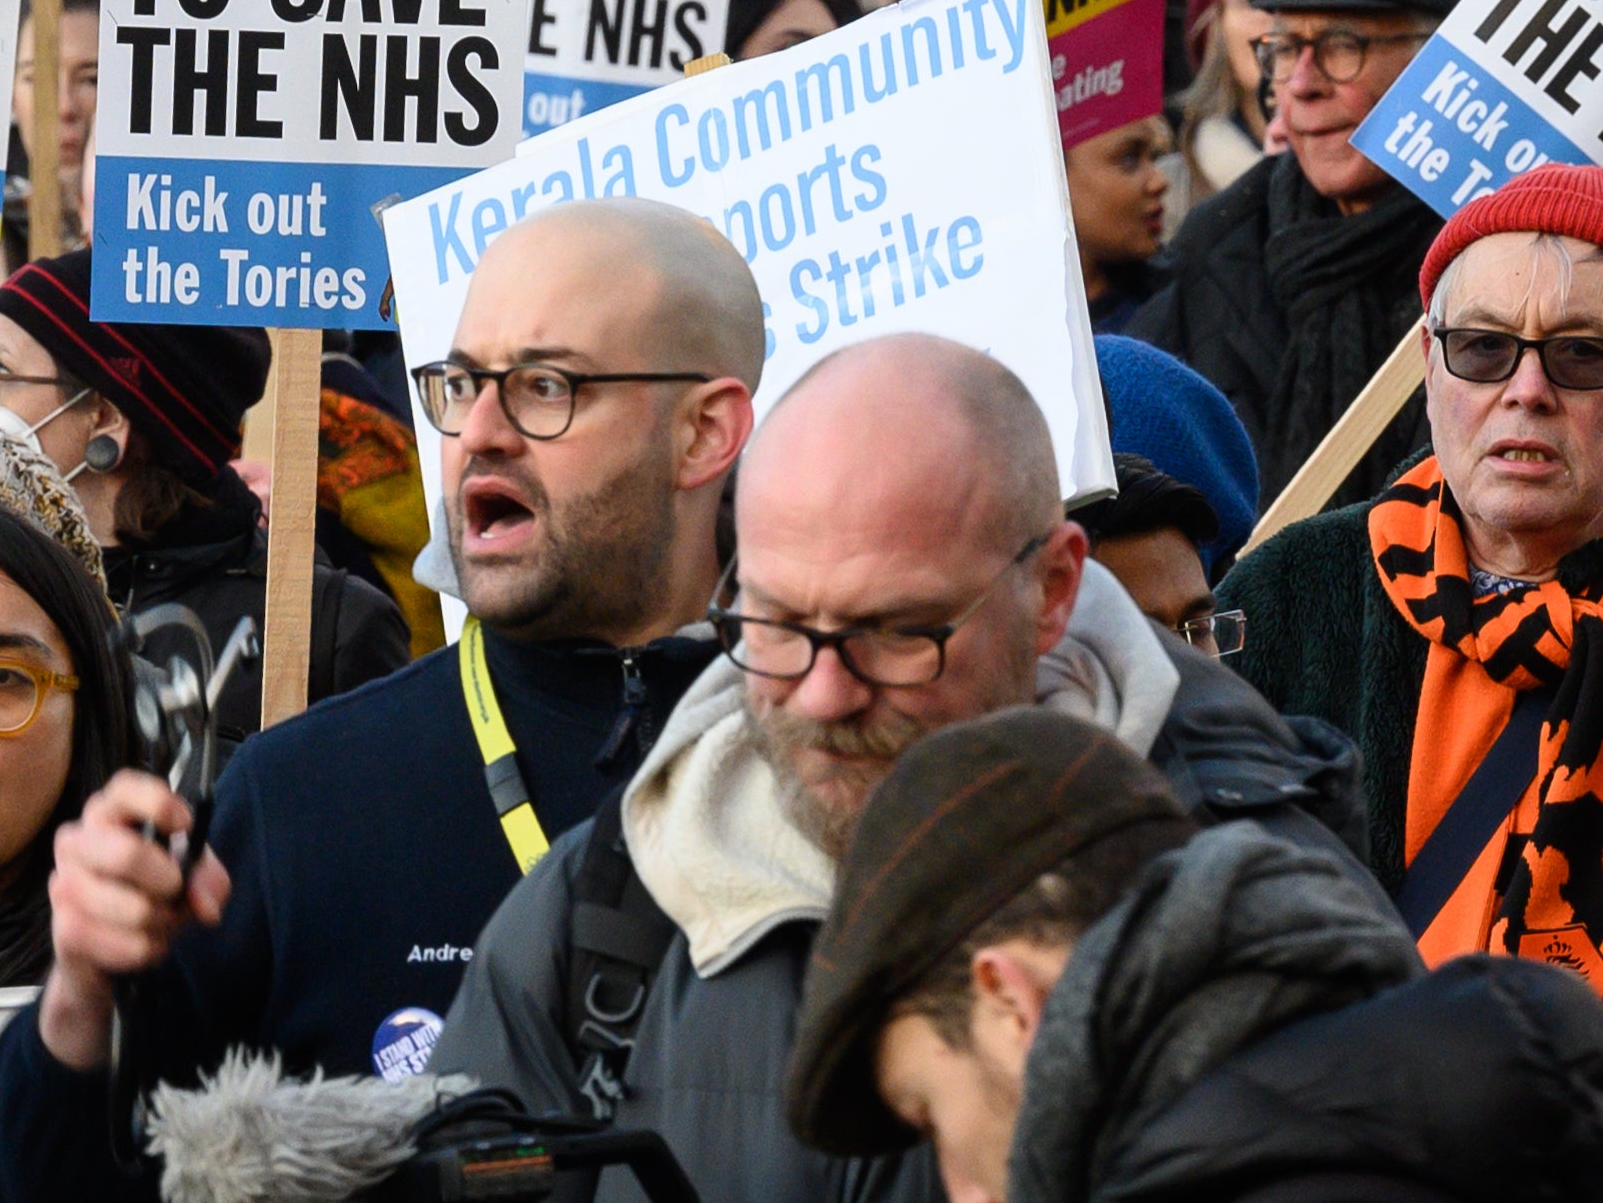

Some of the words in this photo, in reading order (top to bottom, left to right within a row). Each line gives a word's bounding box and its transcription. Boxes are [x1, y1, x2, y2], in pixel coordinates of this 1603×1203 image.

[116, 26, 286, 140] THE
[318, 32, 500, 148] NHS
[1421, 60, 1510, 152] Kick
[1383, 110, 1451, 183] the
[125, 172, 230, 234] Kick
[247, 181, 328, 237] out
[122, 246, 200, 305] the
[218, 248, 367, 310] Tories
[789, 212, 986, 345] Strike
